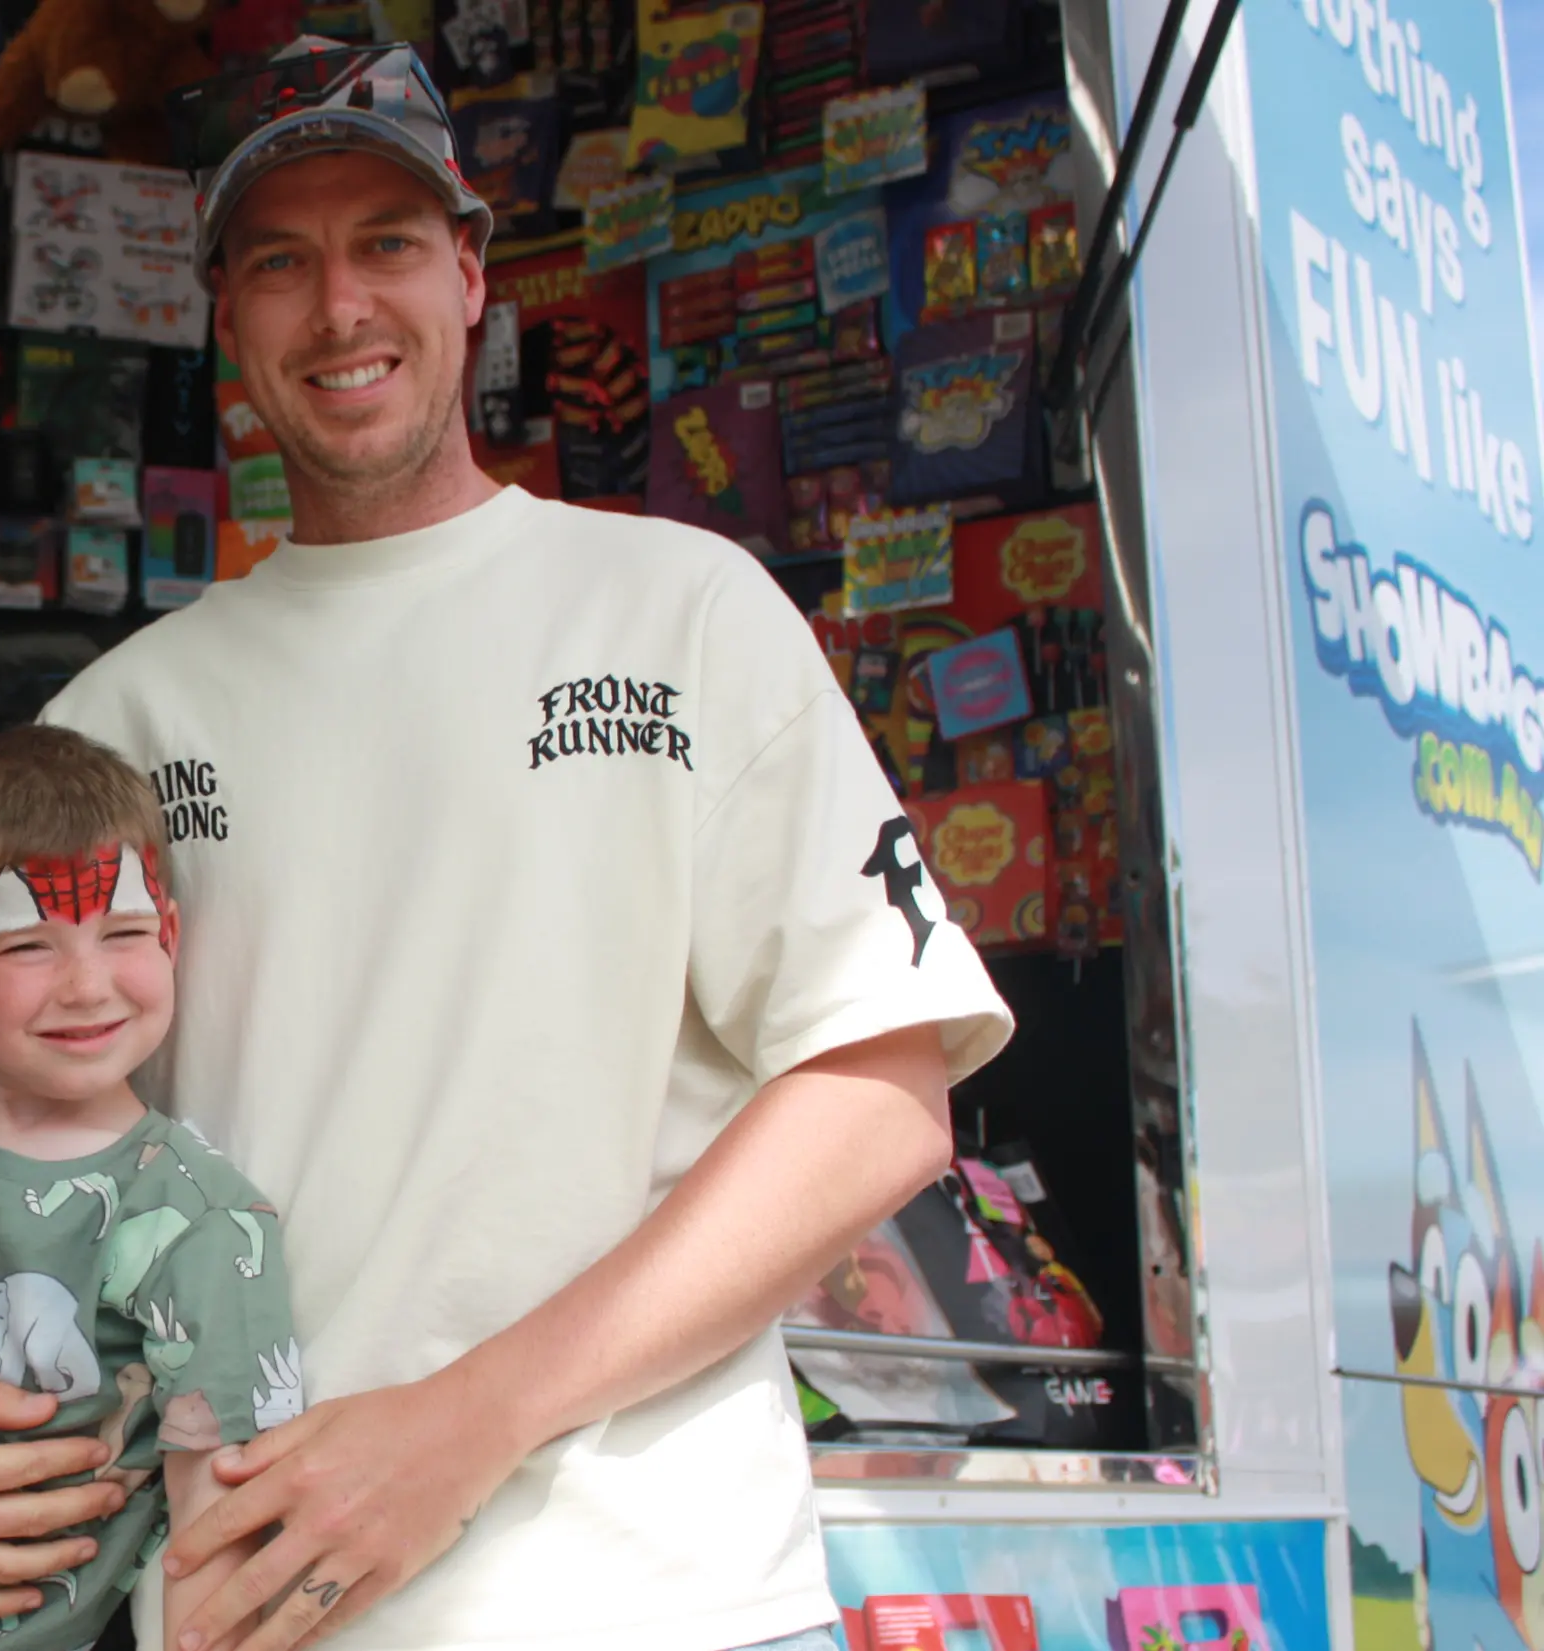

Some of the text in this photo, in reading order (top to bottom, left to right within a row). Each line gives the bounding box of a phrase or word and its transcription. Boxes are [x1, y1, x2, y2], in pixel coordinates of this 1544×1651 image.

[1292, 0, 1491, 249] othing
[1341, 112, 1465, 314] says
[1290, 207, 1533, 541] FUN like
[527, 720, 696, 772] RUNNER
[537, 674, 684, 728] FRONT
[1304, 506, 1544, 774] SHOWBAG
